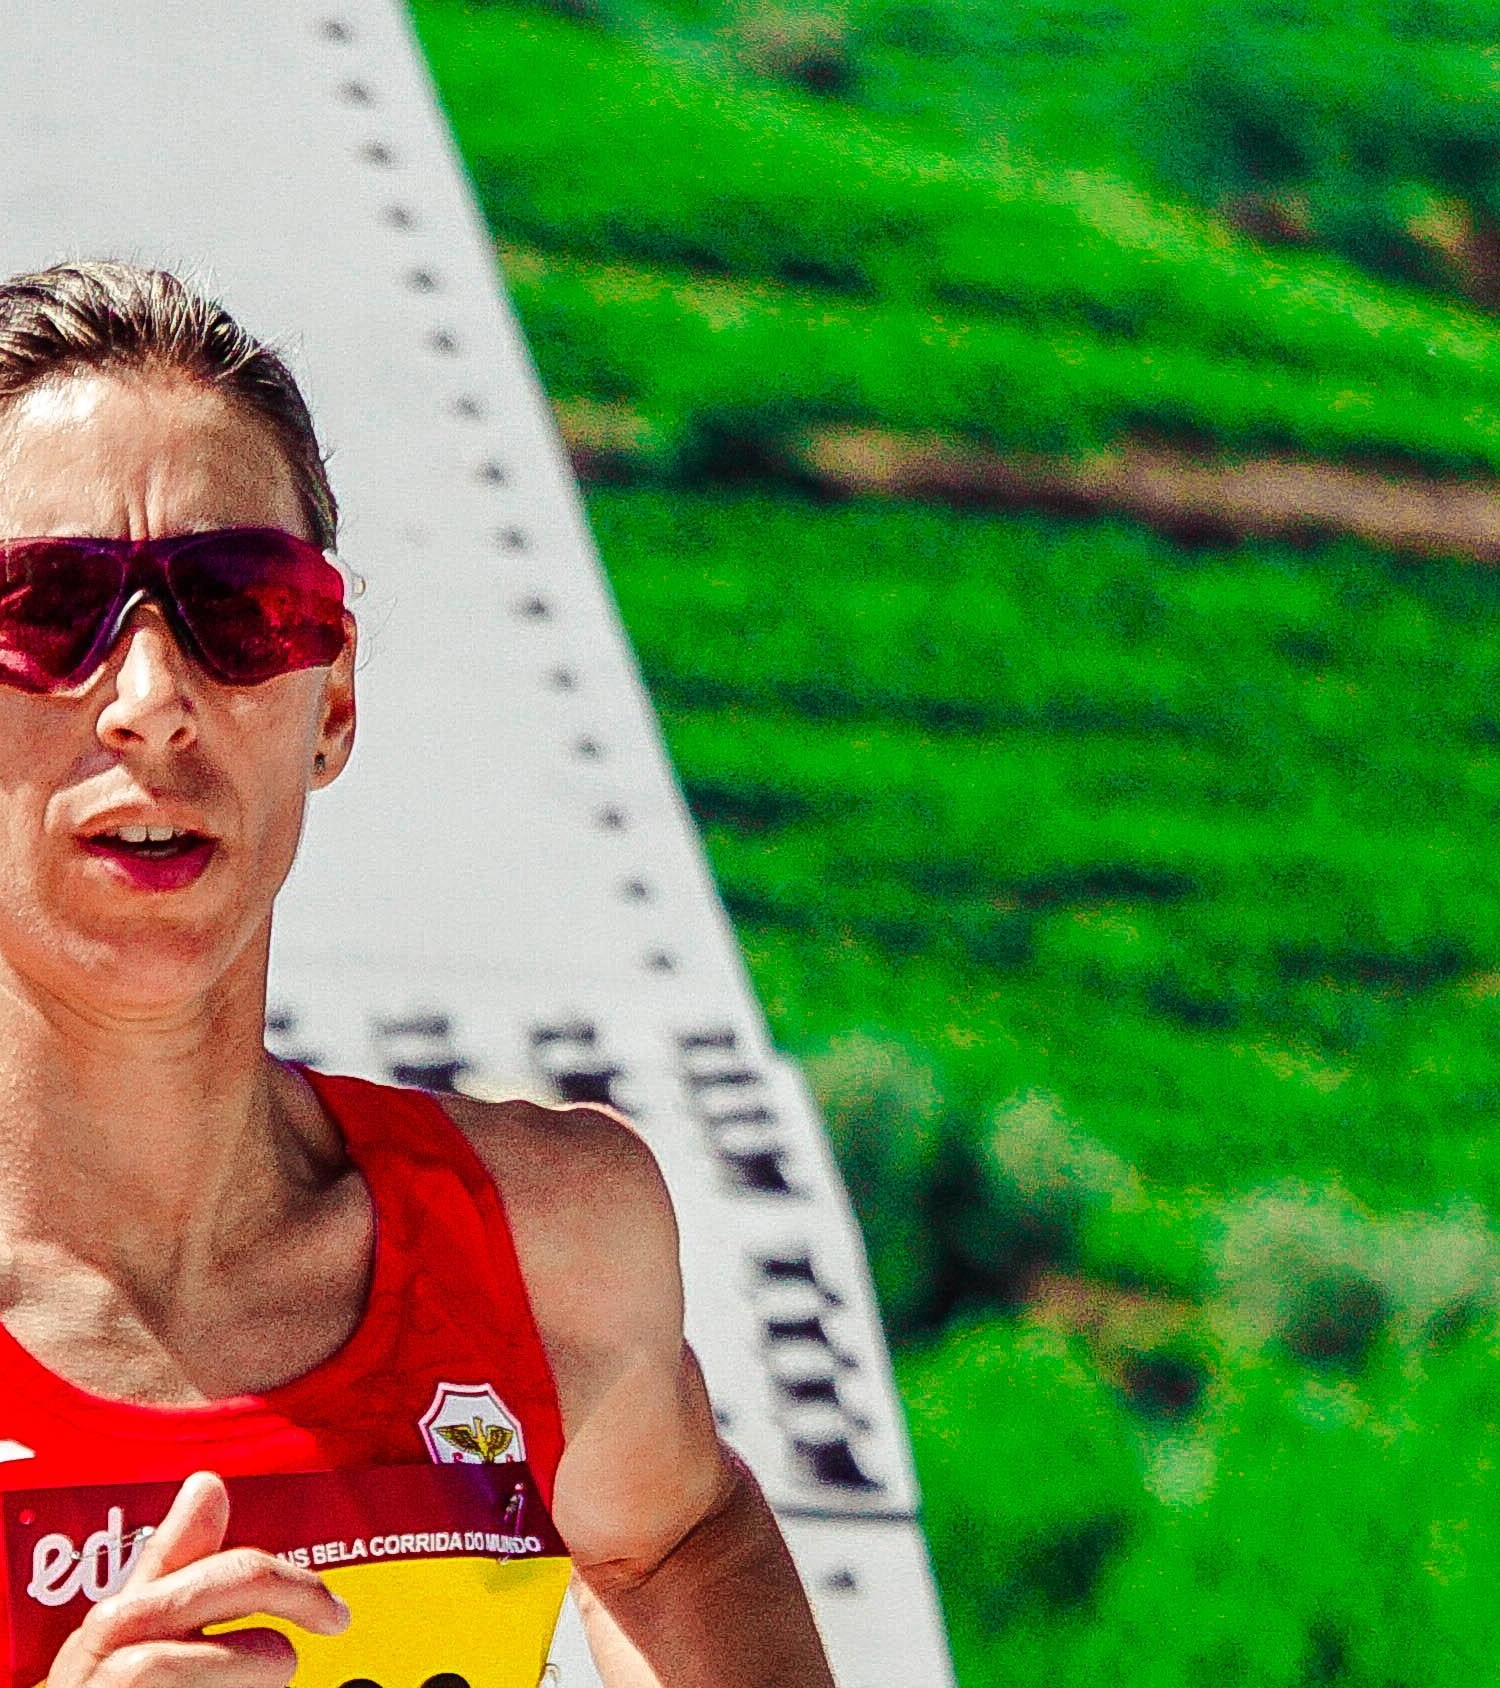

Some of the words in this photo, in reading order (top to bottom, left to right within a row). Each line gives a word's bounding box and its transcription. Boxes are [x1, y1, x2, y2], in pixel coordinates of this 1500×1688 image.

[27, 1506, 148, 1607] ed
[312, 1538, 369, 1564] BELA
[370, 1532, 463, 1557] CORRIDA
[464, 1531, 485, 1551] DO
